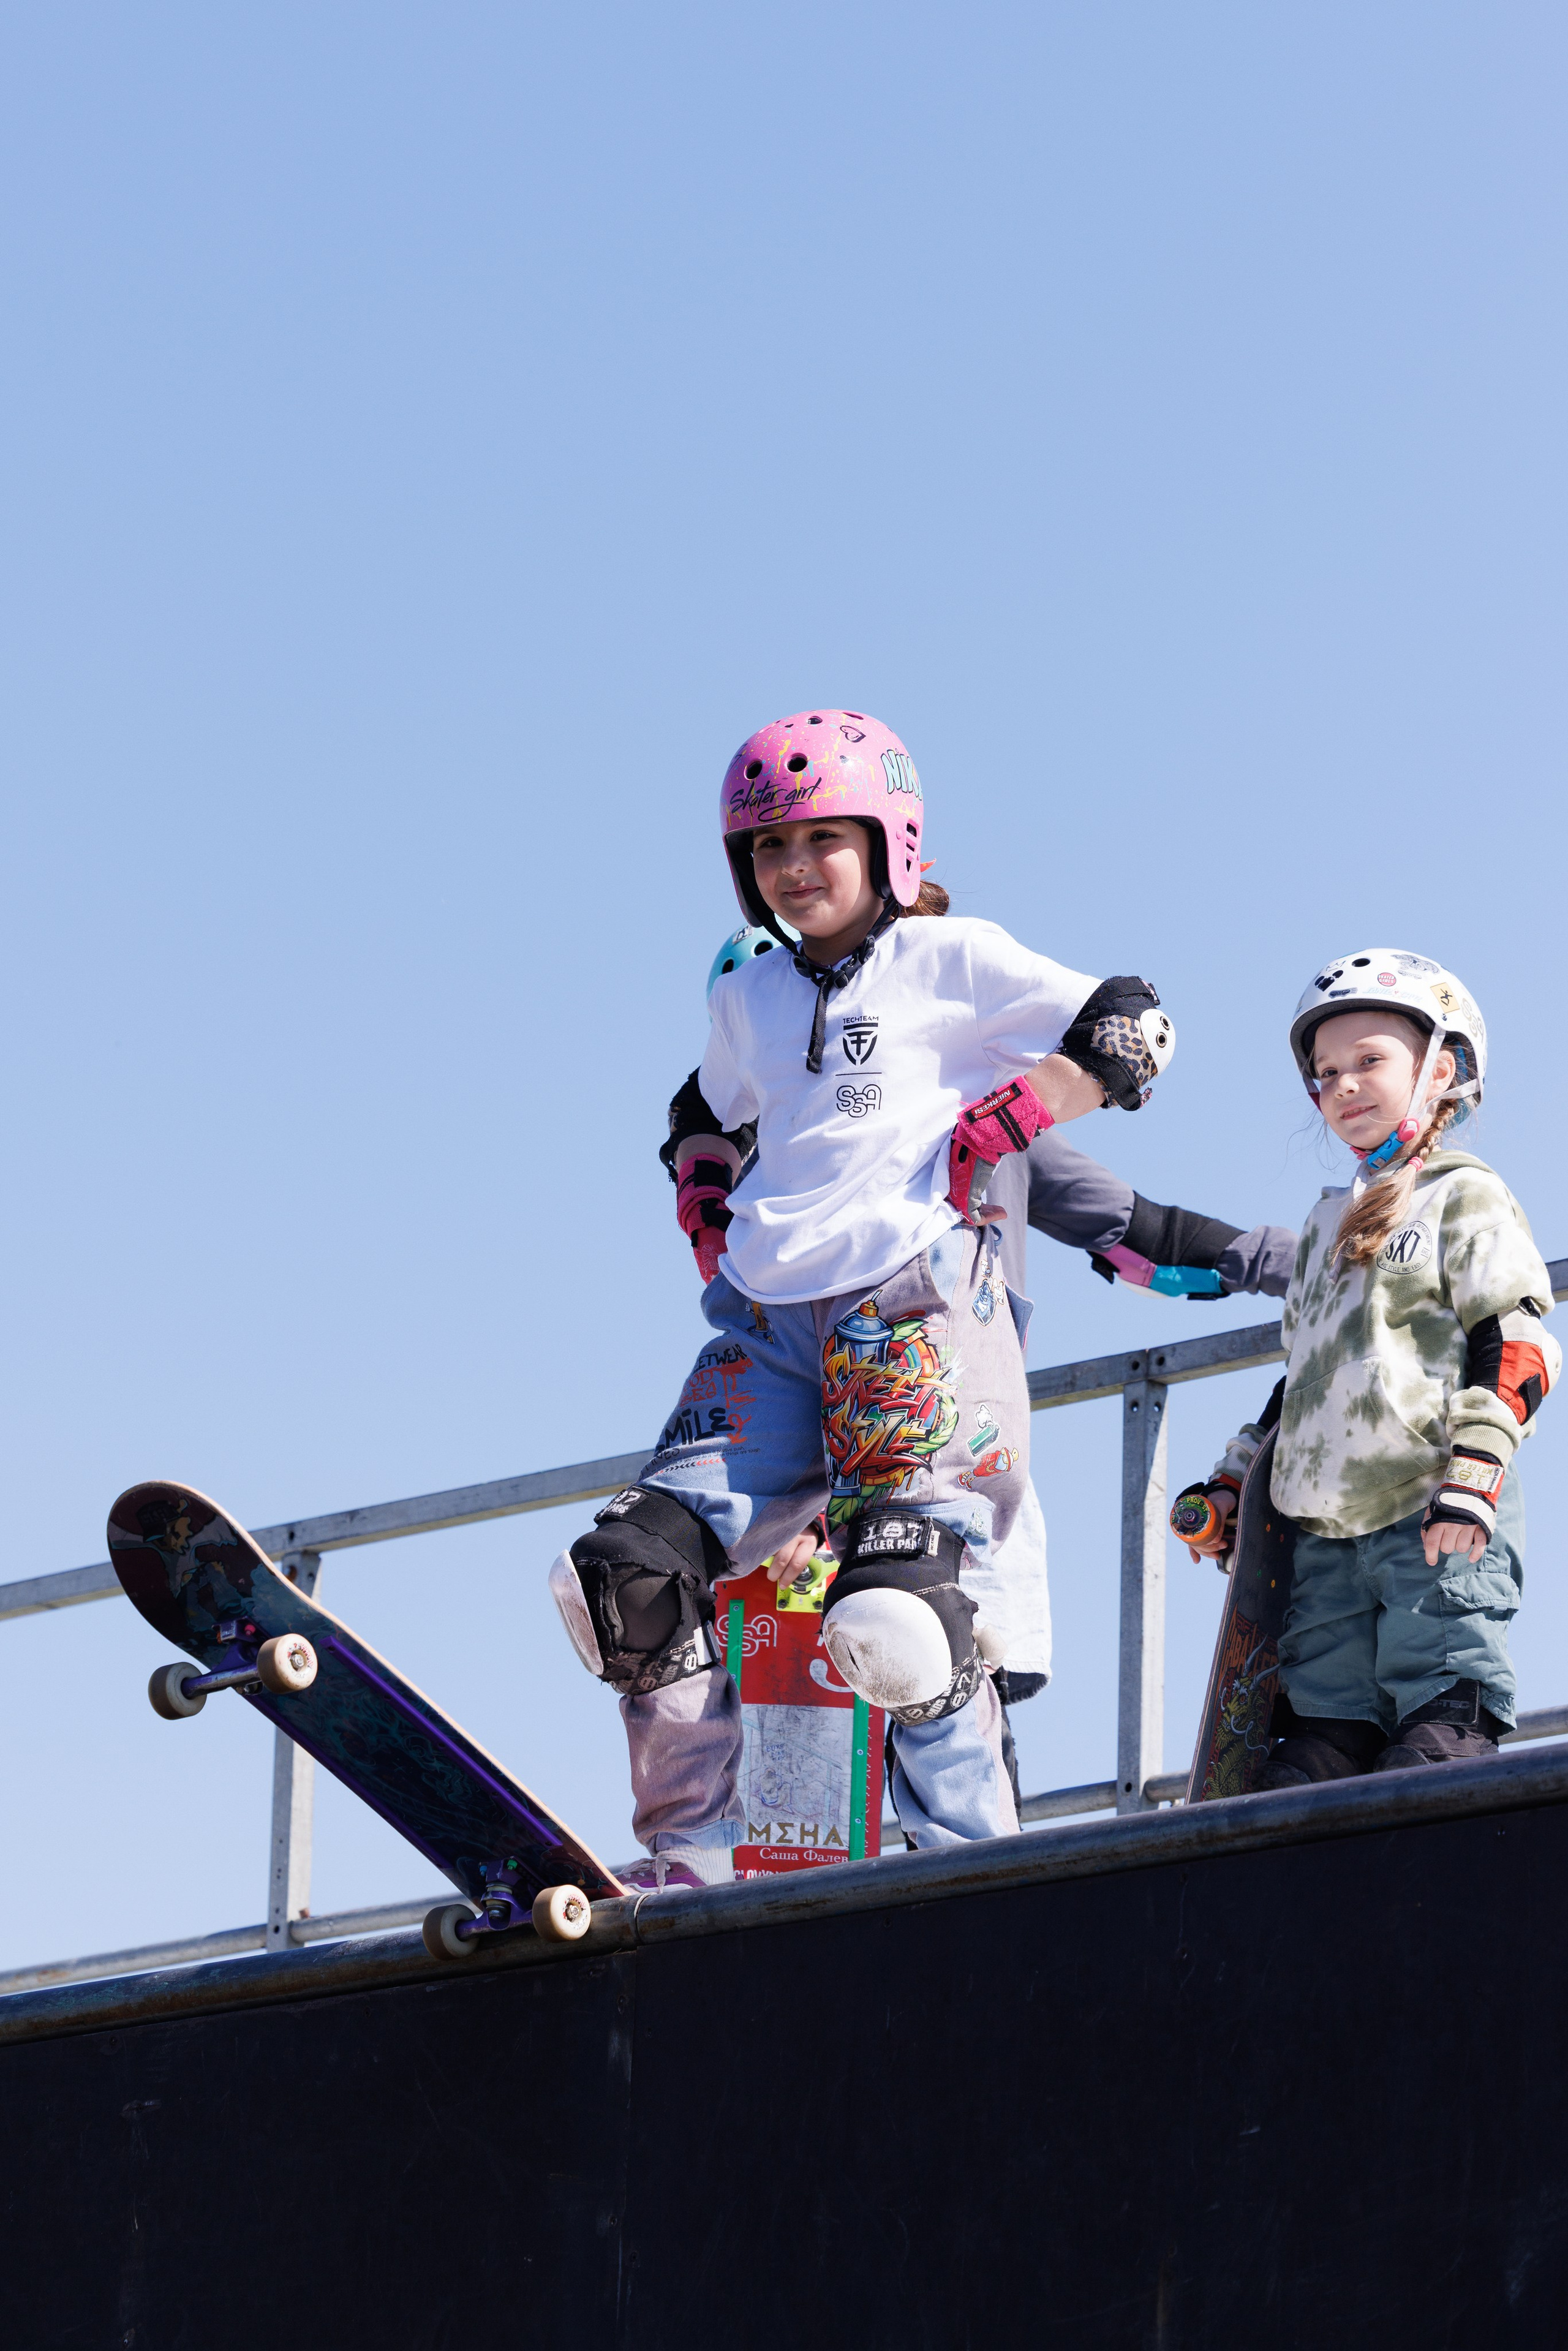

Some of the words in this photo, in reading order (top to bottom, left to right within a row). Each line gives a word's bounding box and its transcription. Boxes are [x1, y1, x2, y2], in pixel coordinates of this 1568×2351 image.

[729, 782, 786, 815] Skater
[758, 777, 822, 822] girl
[842, 1015, 879, 1024] TECHTEAM
[1385, 1229, 1422, 1264] SKT
[858, 1539, 894, 1554] KILLER
[760, 1847, 799, 1860] Саша
